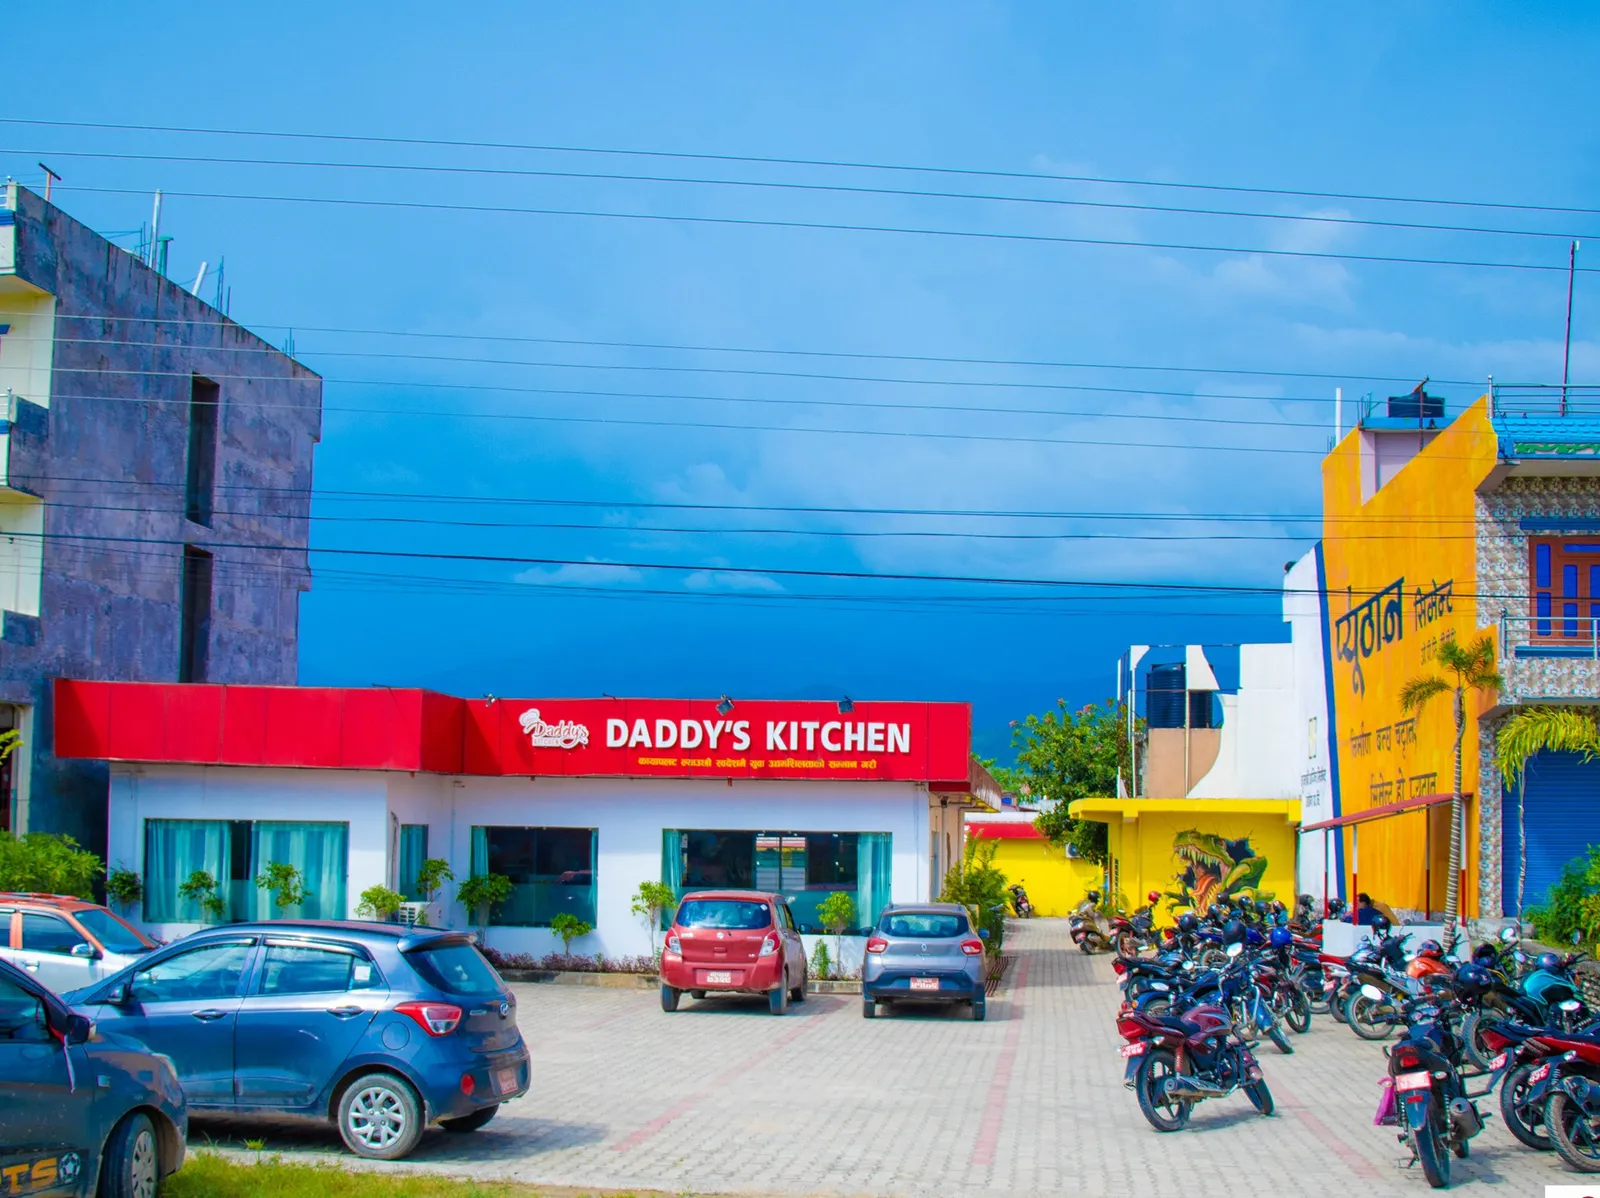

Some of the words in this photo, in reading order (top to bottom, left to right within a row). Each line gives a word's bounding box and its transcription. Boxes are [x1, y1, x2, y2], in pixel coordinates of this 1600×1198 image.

[525, 720, 588, 748] Daddy's
[606, 718, 751, 750] DADDY'S
[766, 721, 911, 753] KITCHEN
[0, 1157, 58, 1195] TS
